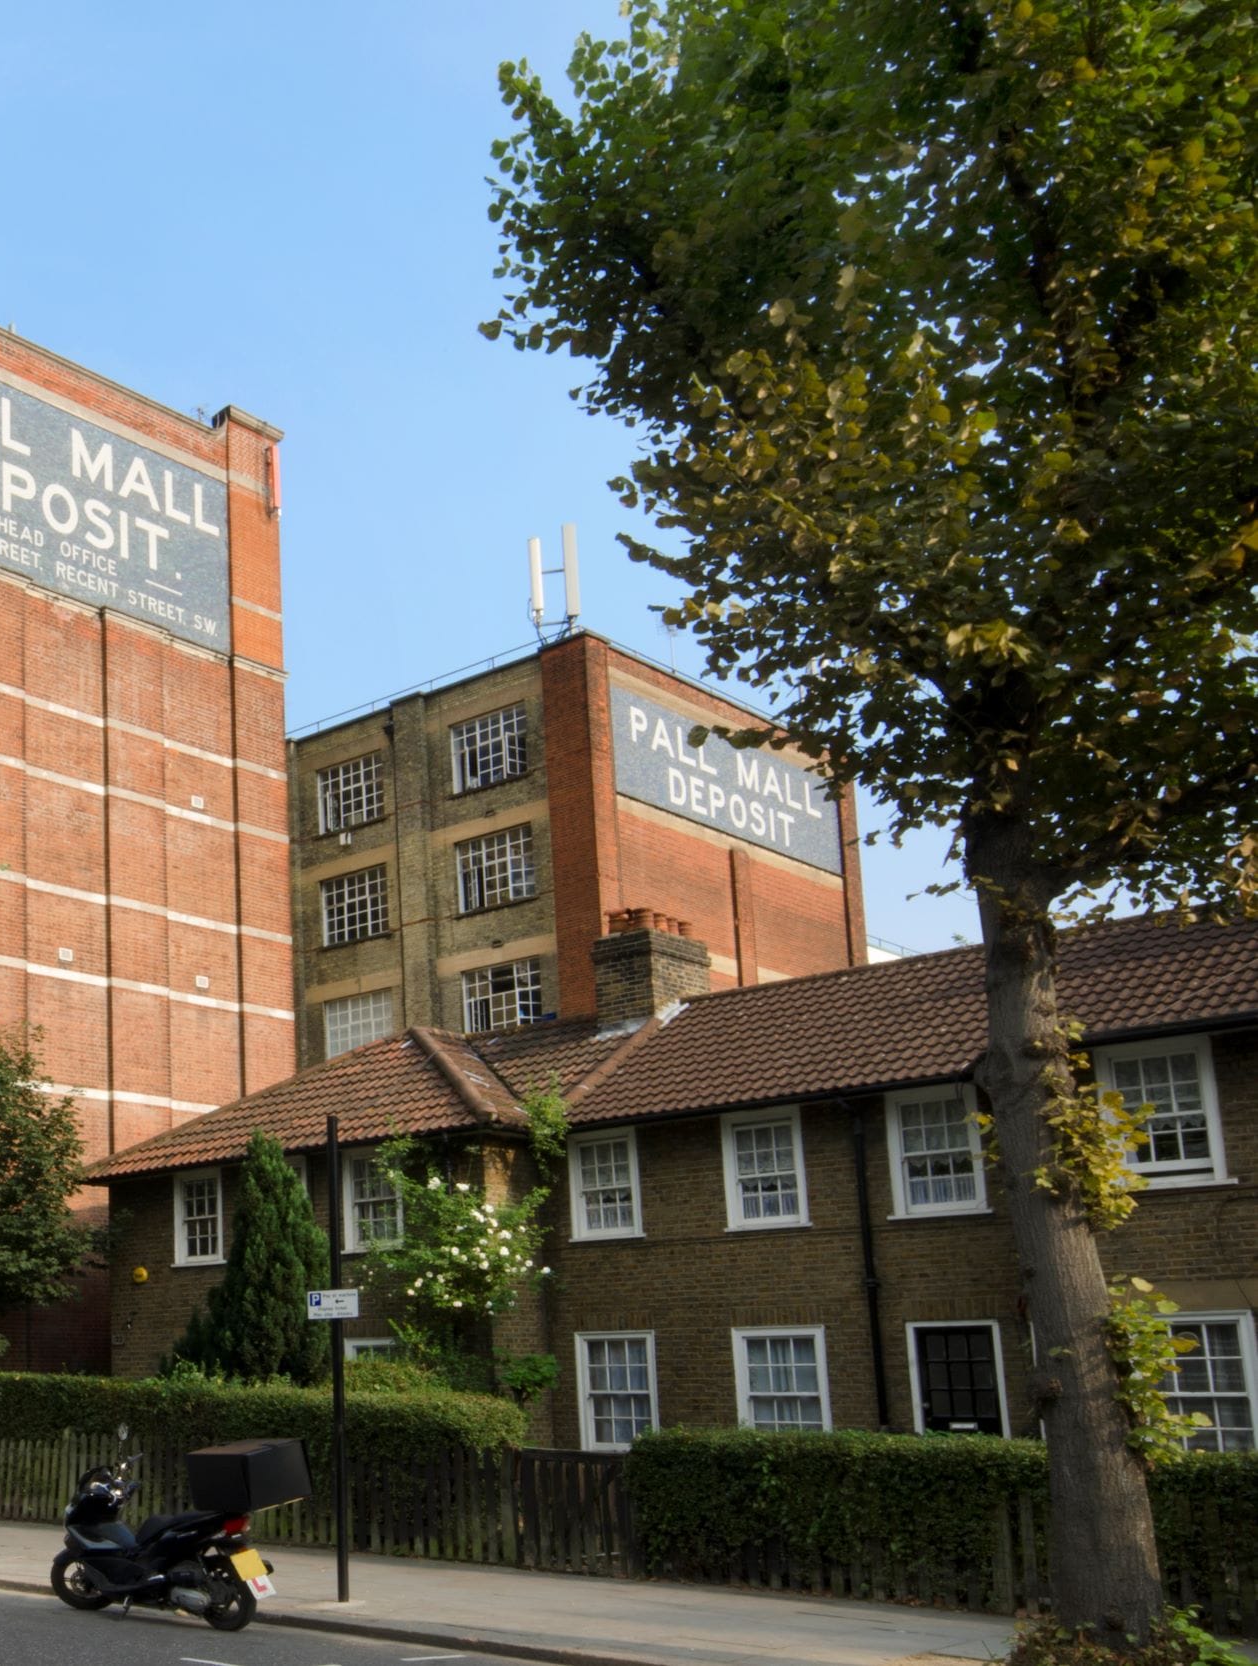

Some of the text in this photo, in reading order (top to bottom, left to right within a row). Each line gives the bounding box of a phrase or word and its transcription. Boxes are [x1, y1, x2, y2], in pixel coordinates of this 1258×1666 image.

[71, 427, 220, 537] MALL
[59, 541, 118, 577] OFFICE
[629, 706, 822, 819] PALL MALL
[668, 767, 795, 848] DEPOSIT
